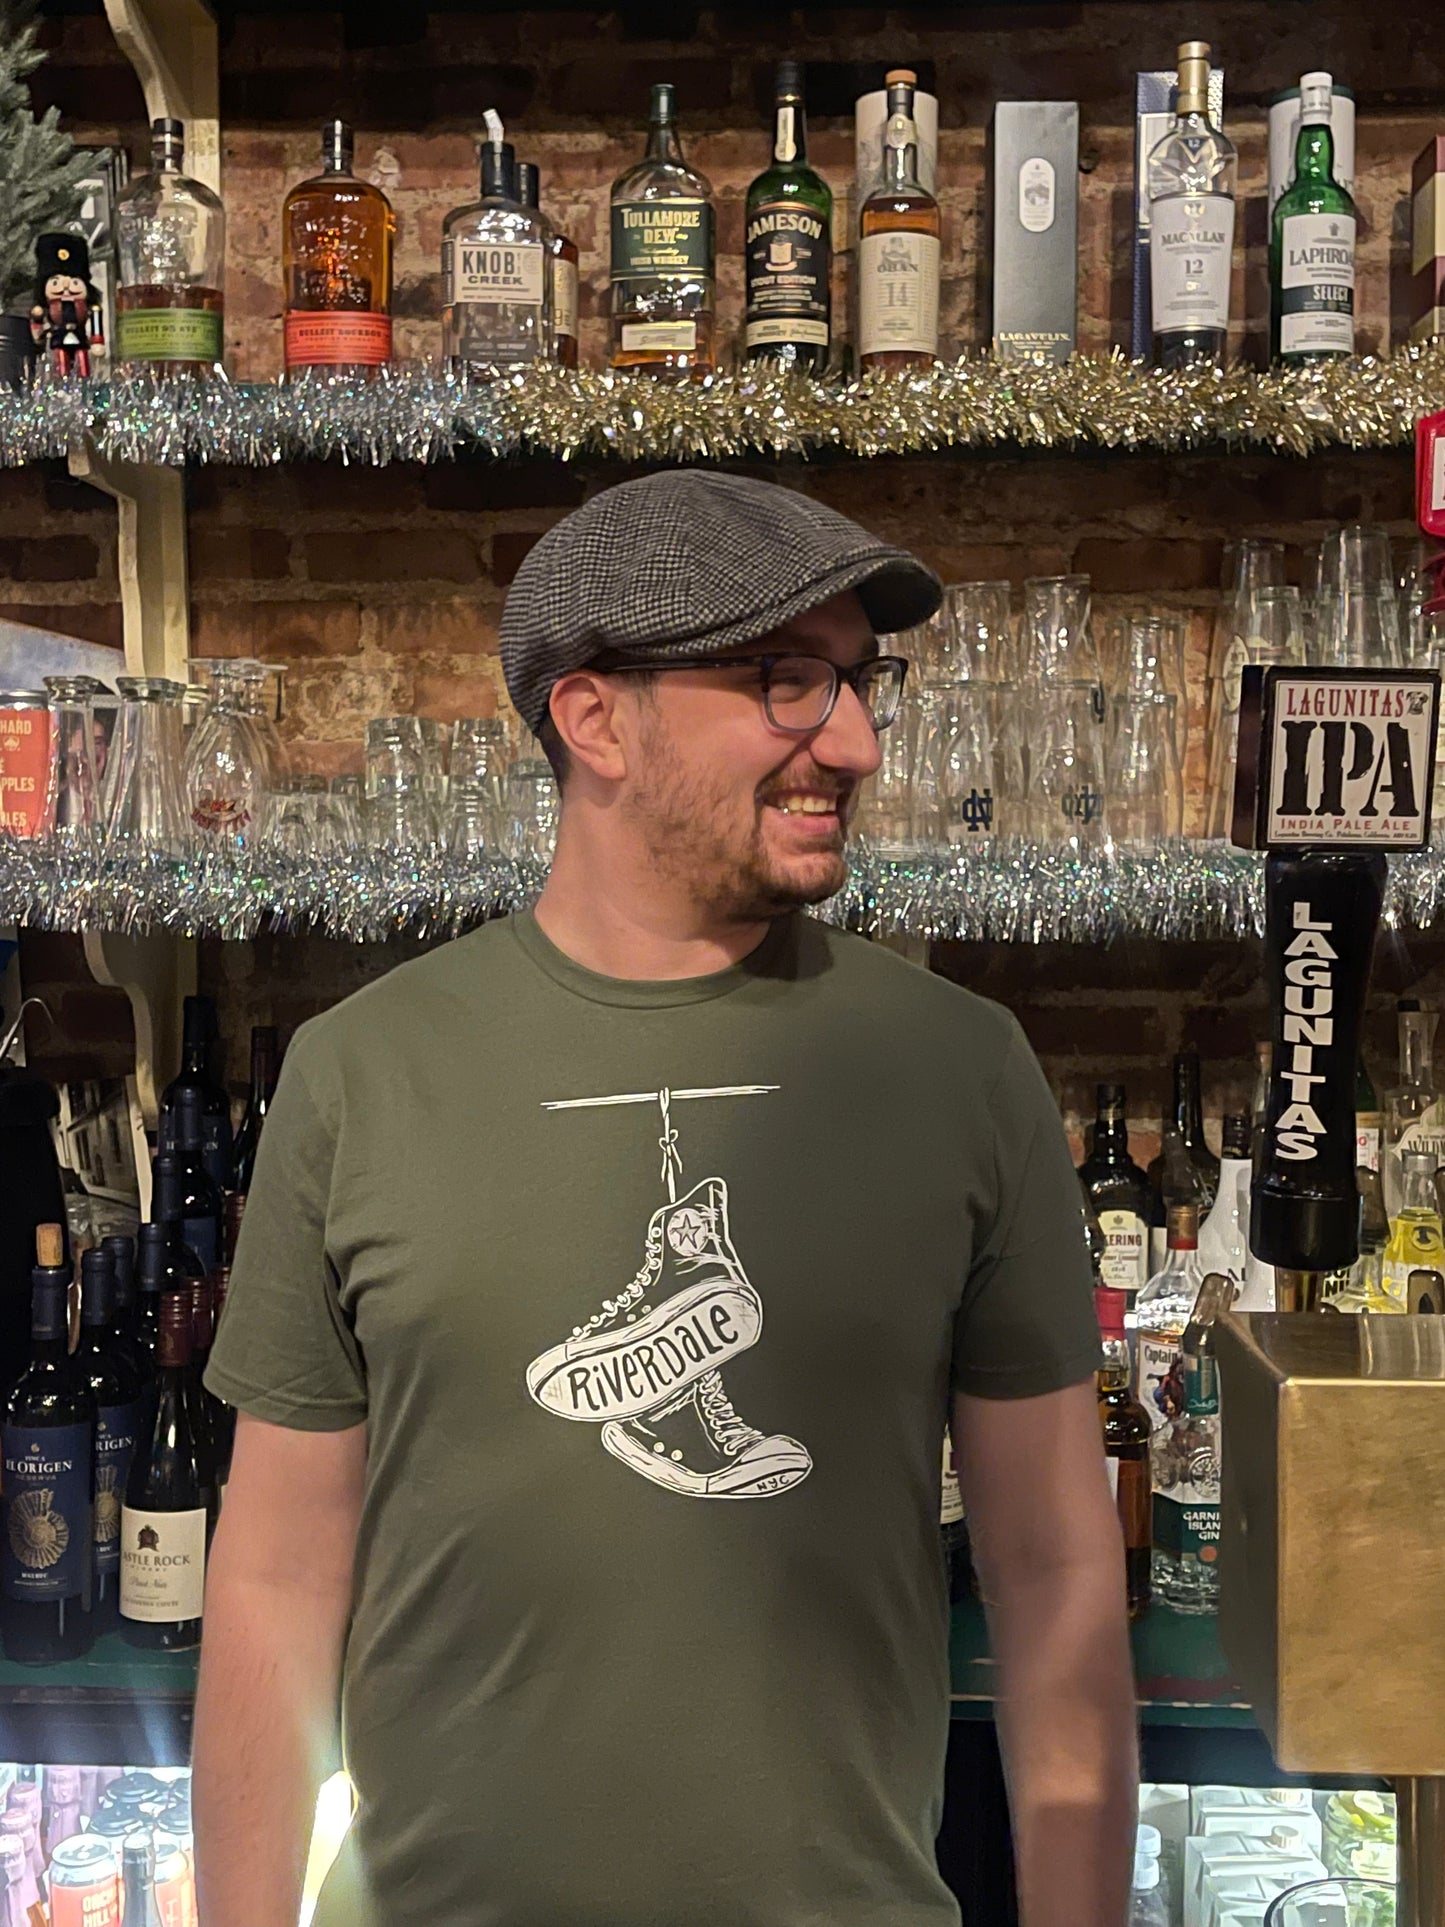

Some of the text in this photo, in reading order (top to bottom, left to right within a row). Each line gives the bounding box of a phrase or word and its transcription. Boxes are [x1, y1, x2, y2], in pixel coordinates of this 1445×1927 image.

[747, 213, 822, 244] JAMESON
[462, 251, 515, 275] KNOB
[877, 263, 919, 273] OBAN
[1184, 259, 1204, 275] 12
[468, 275, 523, 285] CREEK
[1286, 688, 1405, 718] LAGUNITAS
[1276, 720, 1420, 817] IPA
[0, 777, 35, 792] PPLES
[1280, 818, 1411, 831] INDIA PALE ALE
[1274, 901, 1340, 1161] LAGUNITAS
[17, 1460, 73, 1474] ORIGEN
[1182, 1511, 1220, 1521] GARNI
[1198, 1531, 1220, 1541] GIN
[123, 1551, 190, 1567] ASTLE ROCK
